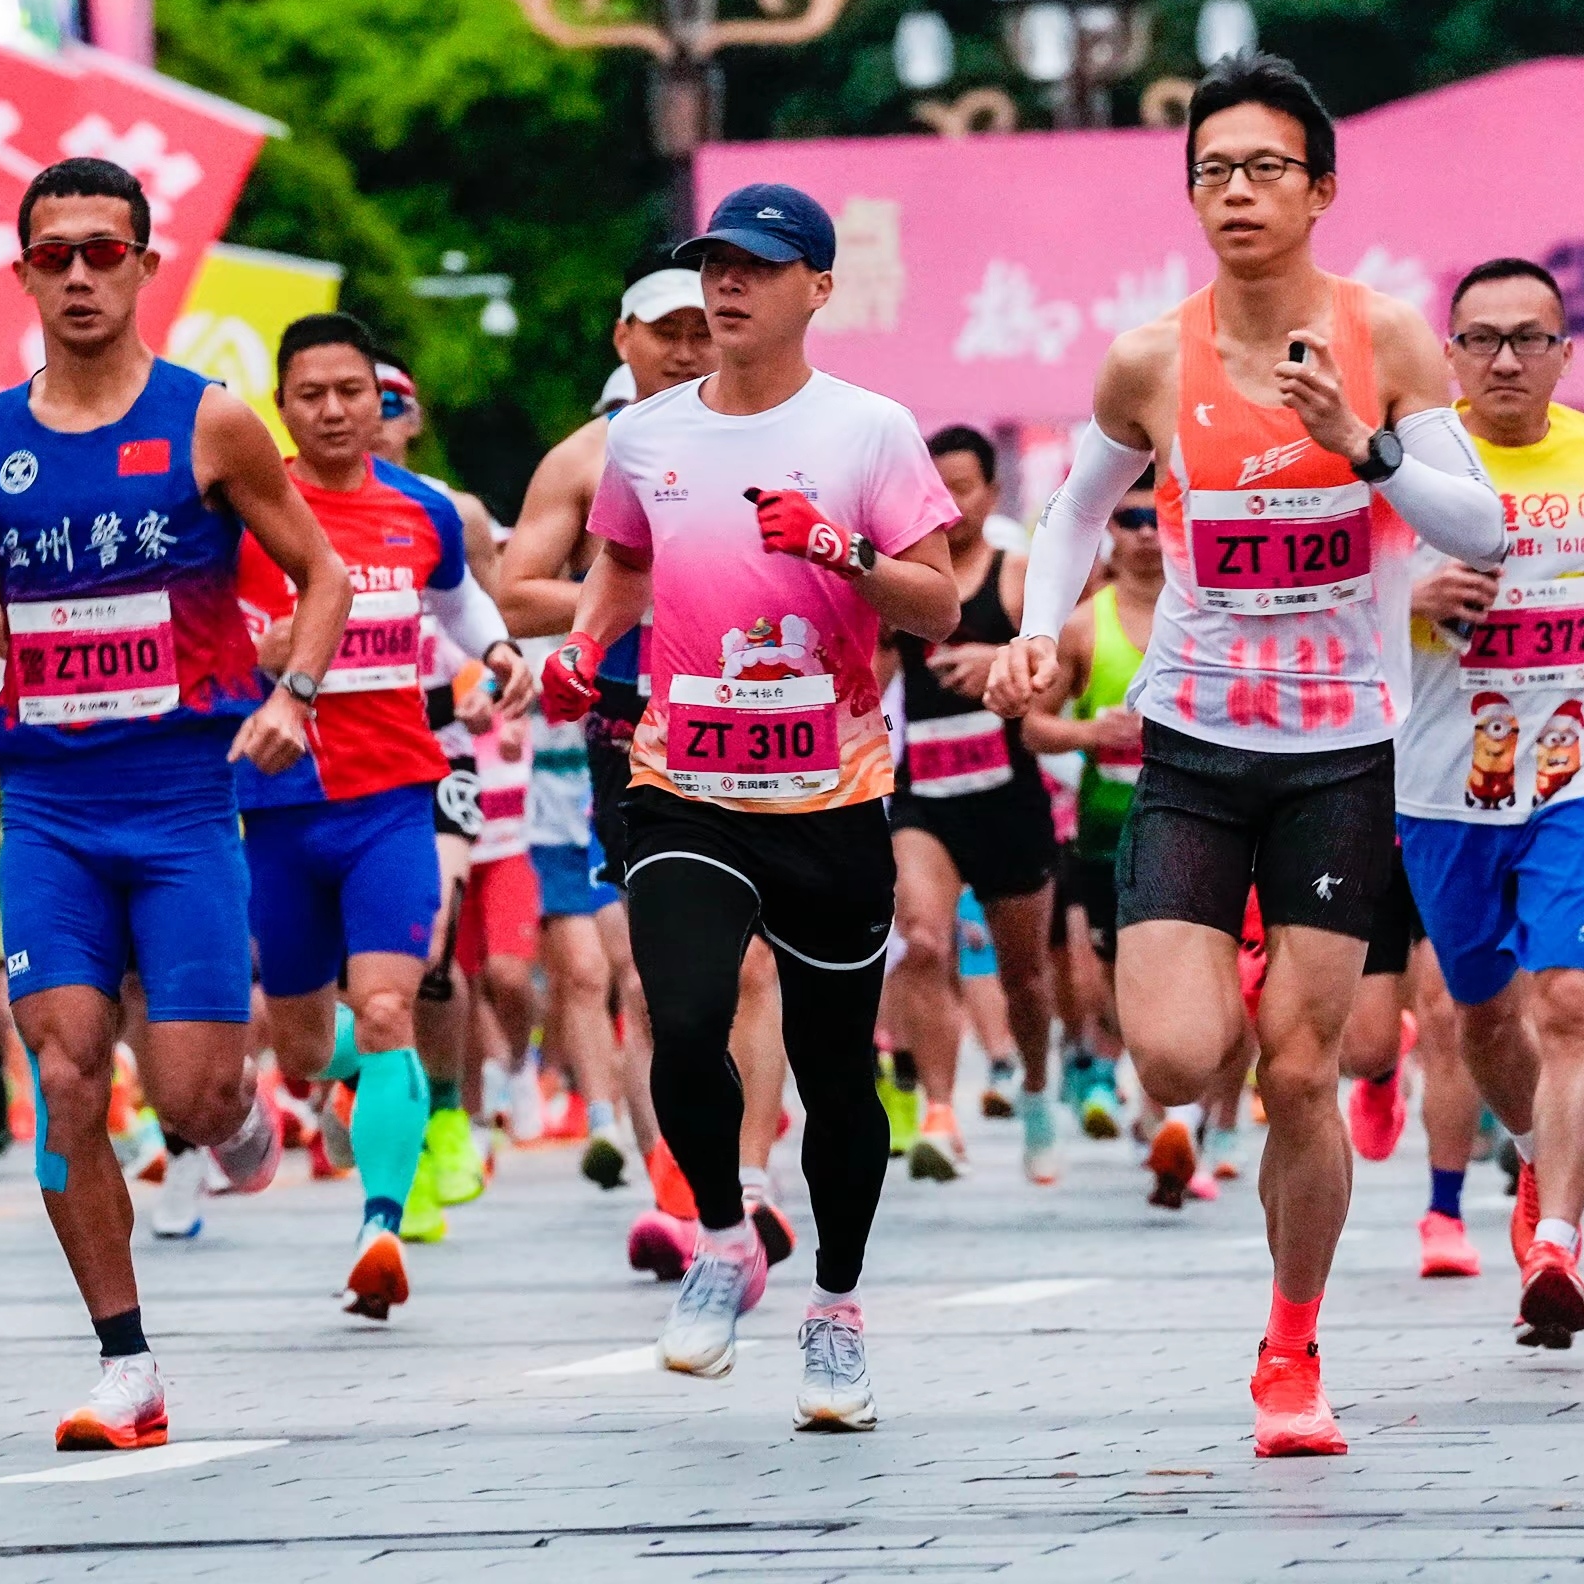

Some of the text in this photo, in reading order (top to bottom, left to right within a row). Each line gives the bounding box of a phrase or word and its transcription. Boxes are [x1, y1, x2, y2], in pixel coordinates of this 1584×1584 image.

[1216, 529, 1352, 575] ZT 120
[55, 637, 160, 680] ZT010
[1476, 621, 1521, 658] ZT
[686, 719, 815, 760] ZT 310
